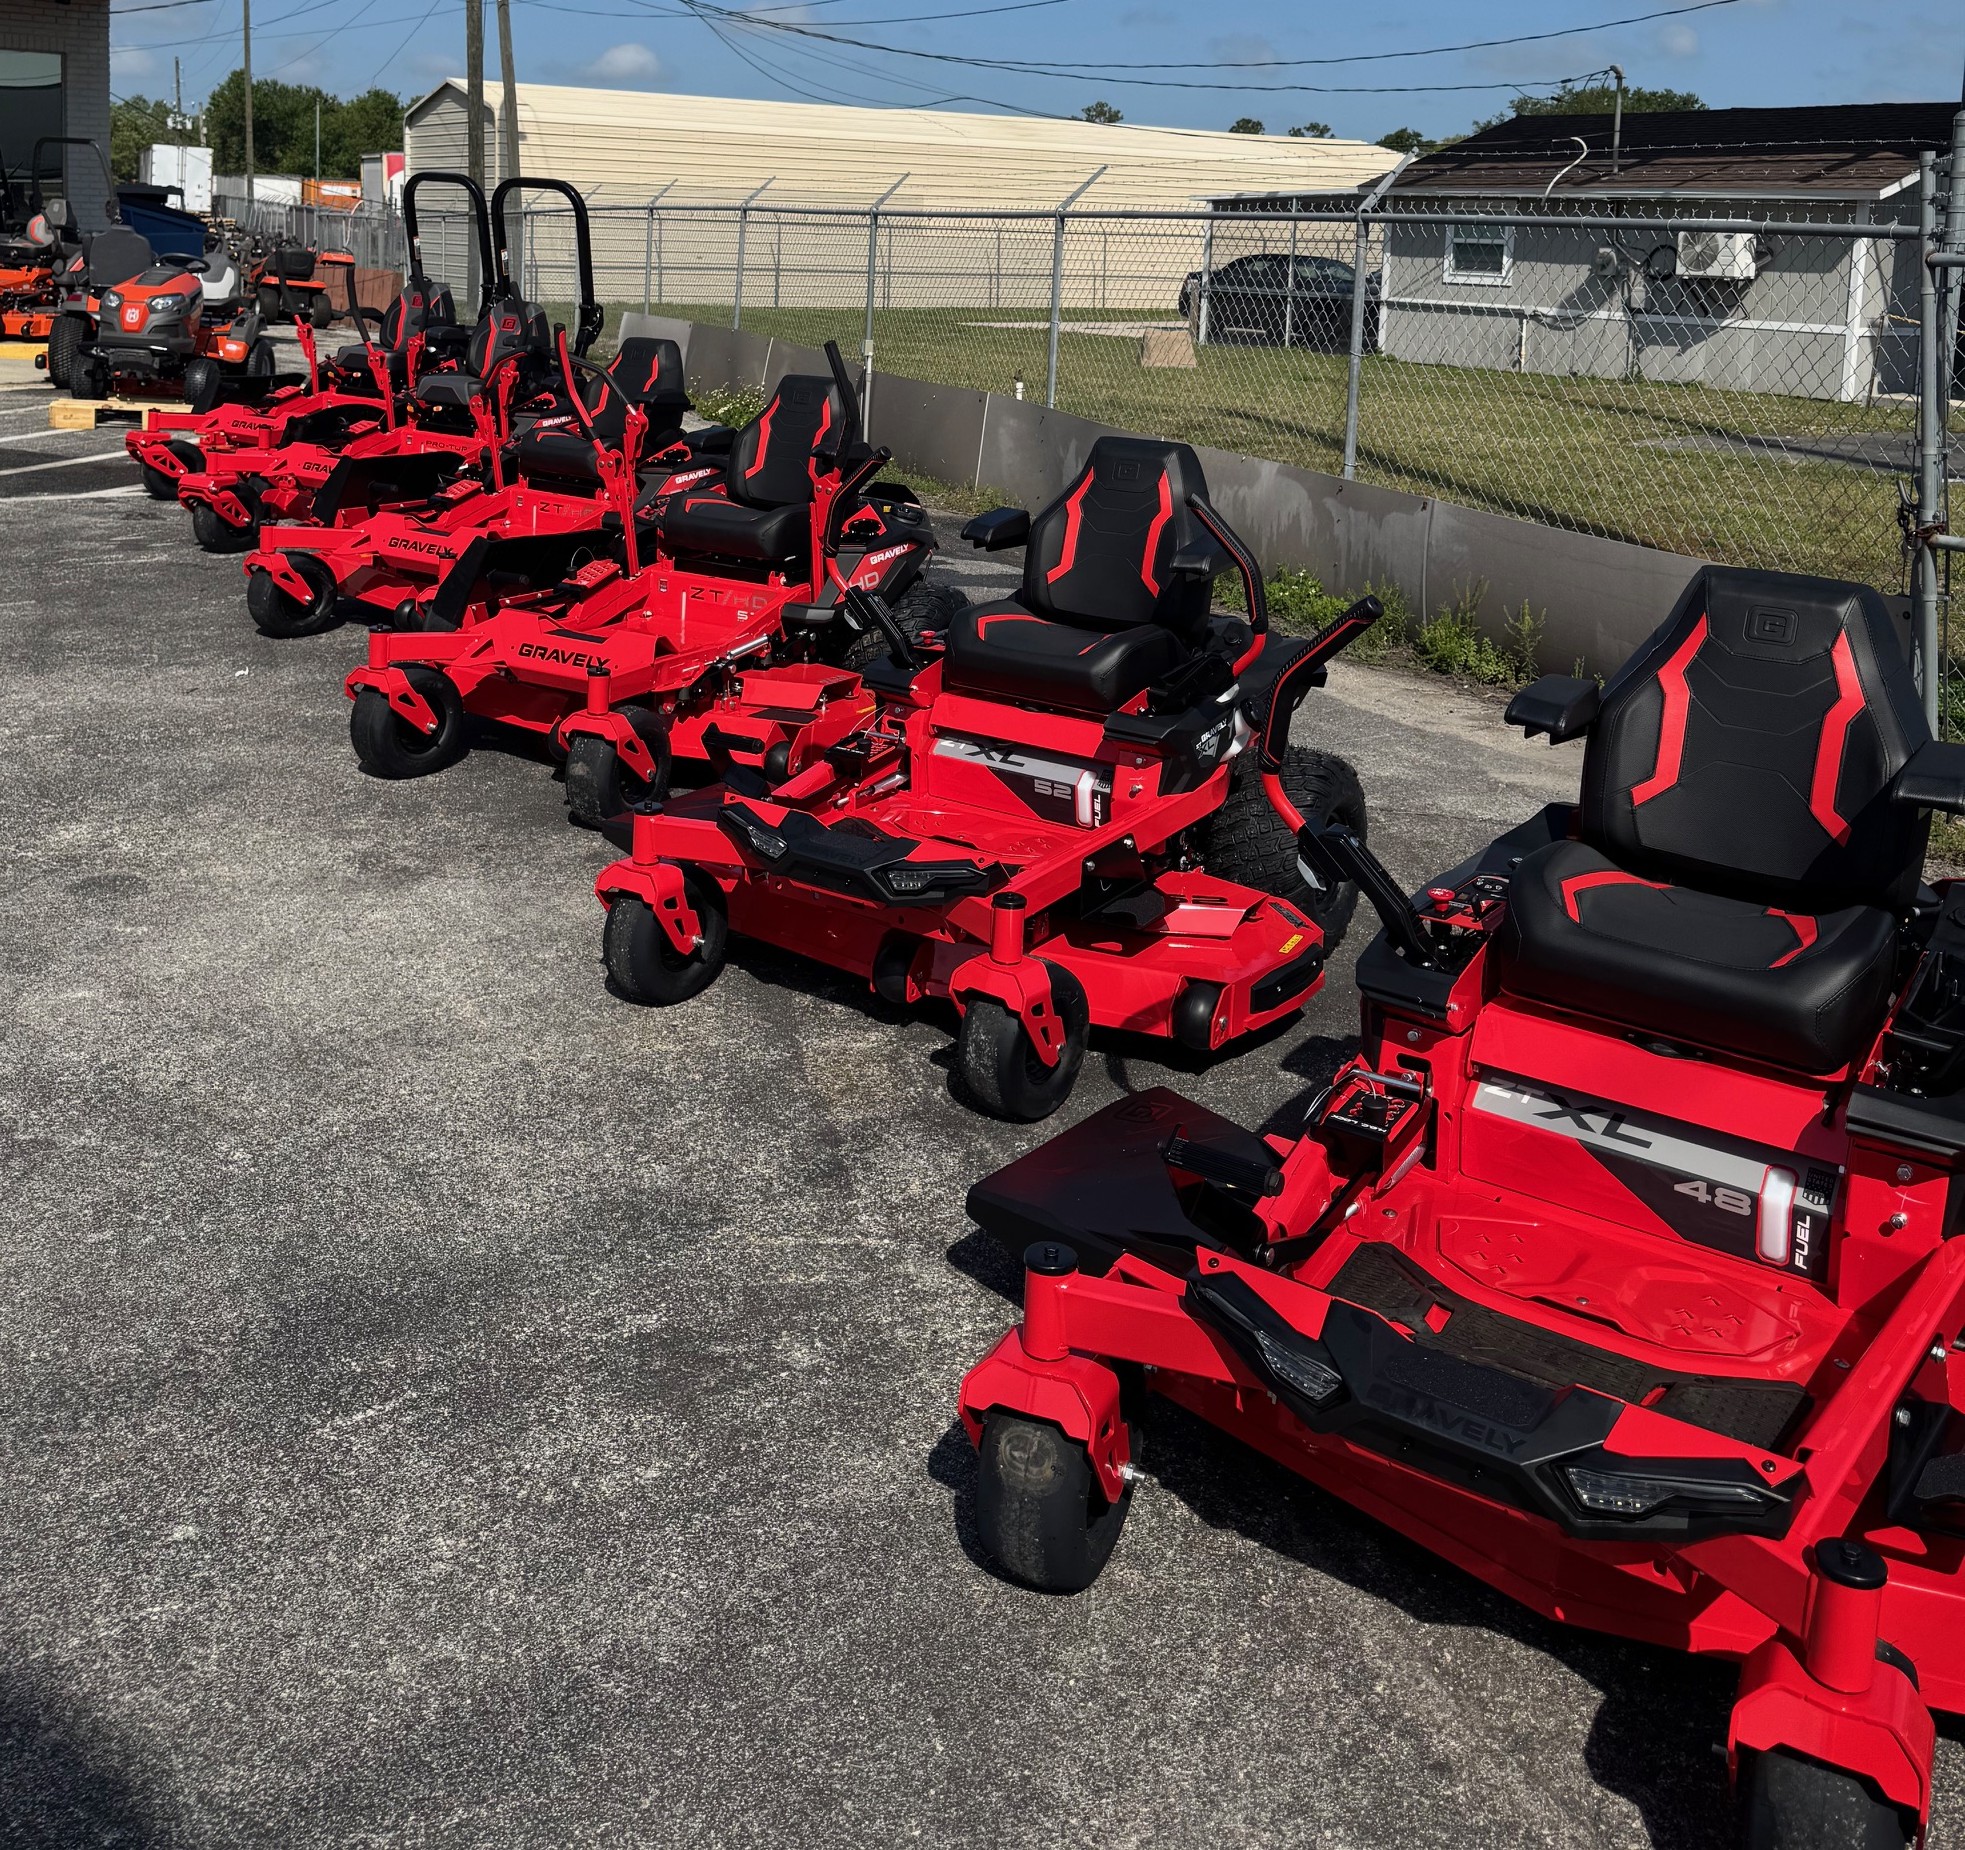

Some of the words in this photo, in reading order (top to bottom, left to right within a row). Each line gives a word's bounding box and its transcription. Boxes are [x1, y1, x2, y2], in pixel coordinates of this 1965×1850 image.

[542, 415, 572, 427] GRAVELY
[675, 468, 711, 485] GRAVELY
[388, 536, 455, 556] GRAVELY
[869, 543, 909, 565] GRAVELY
[518, 642, 611, 670] GRAVELY
[965, 741, 1025, 768] XL
[1034, 778, 1072, 800] 52
[1093, 794, 1101, 828] FUEL
[1484, 1076, 1545, 1104] ZT
[1532, 1092, 1652, 1149] XL
[1807, 1177, 1833, 1189] STATES
[1808, 1172, 1834, 1184] UNITED
[1673, 1180, 1751, 1216] 48
[1794, 1215, 1811, 1270] FUEL
